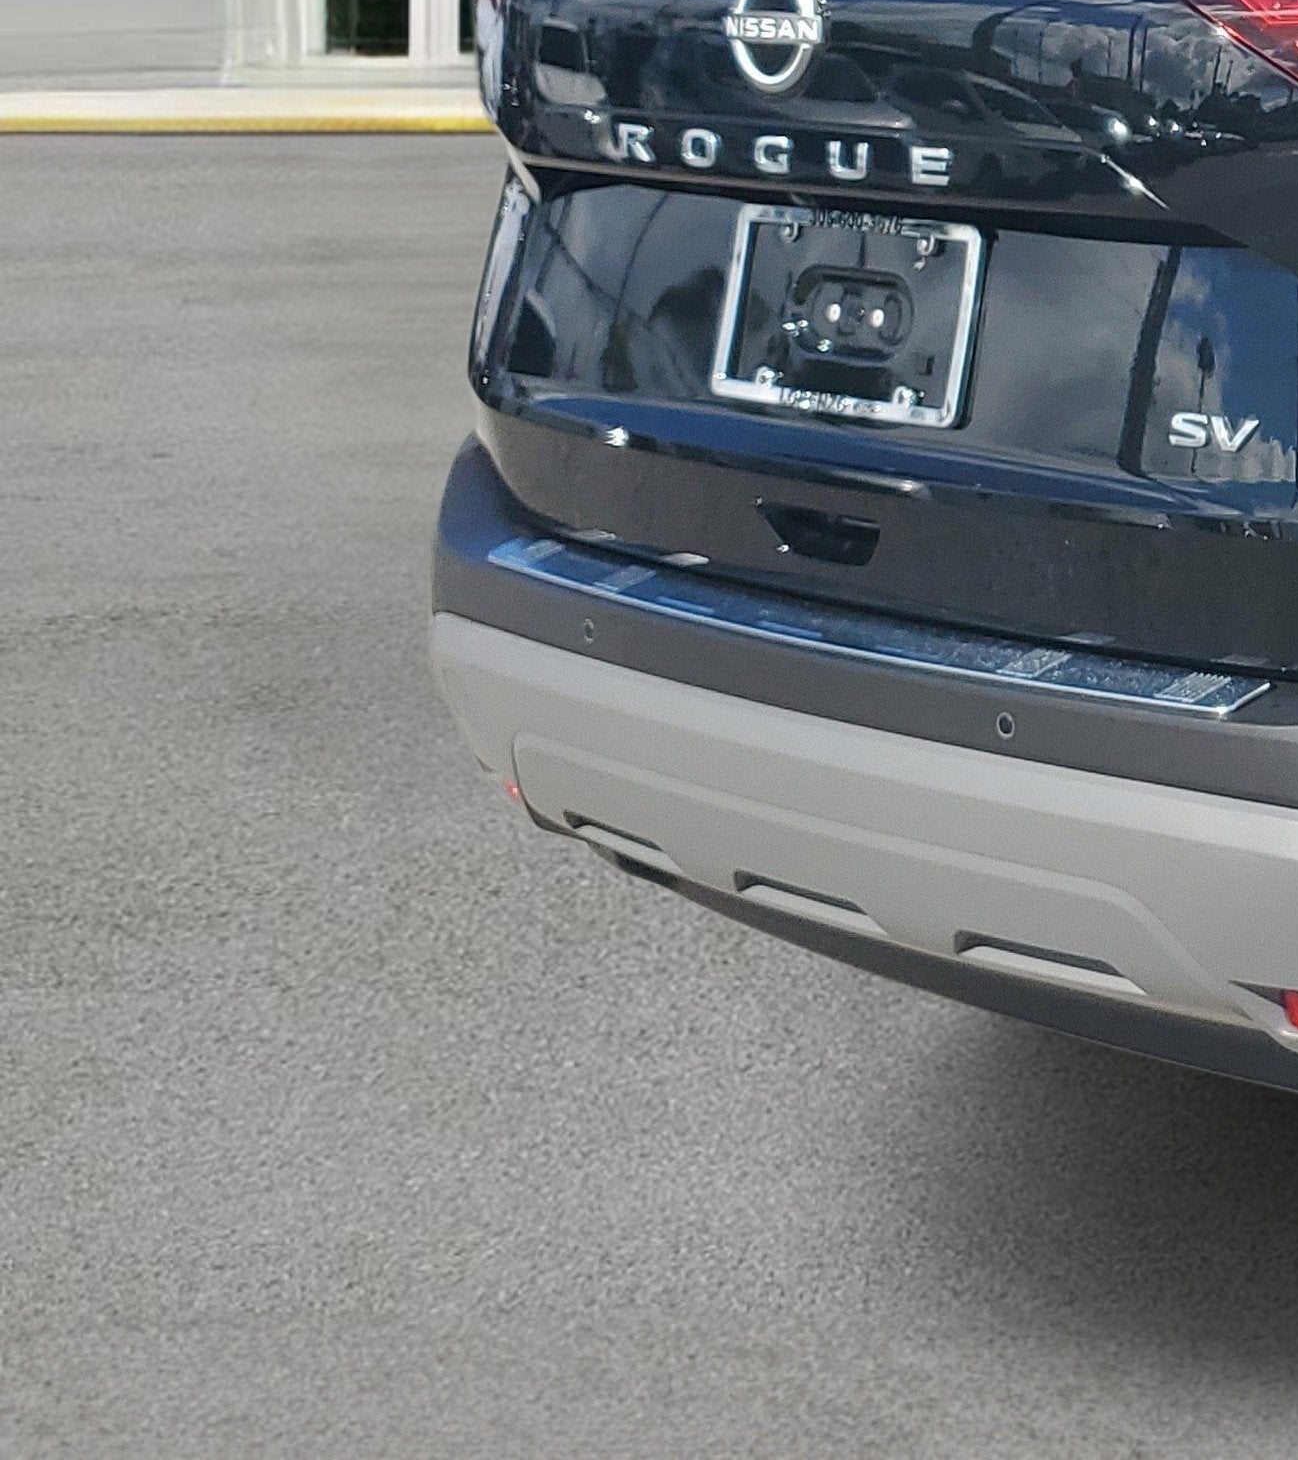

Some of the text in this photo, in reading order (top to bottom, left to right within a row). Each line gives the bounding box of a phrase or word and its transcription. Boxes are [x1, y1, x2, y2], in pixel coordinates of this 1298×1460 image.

[725, 14, 820, 41] NISSAN
[614, 123, 953, 187] ROGUE
[1168, 411, 1260, 453] SV
